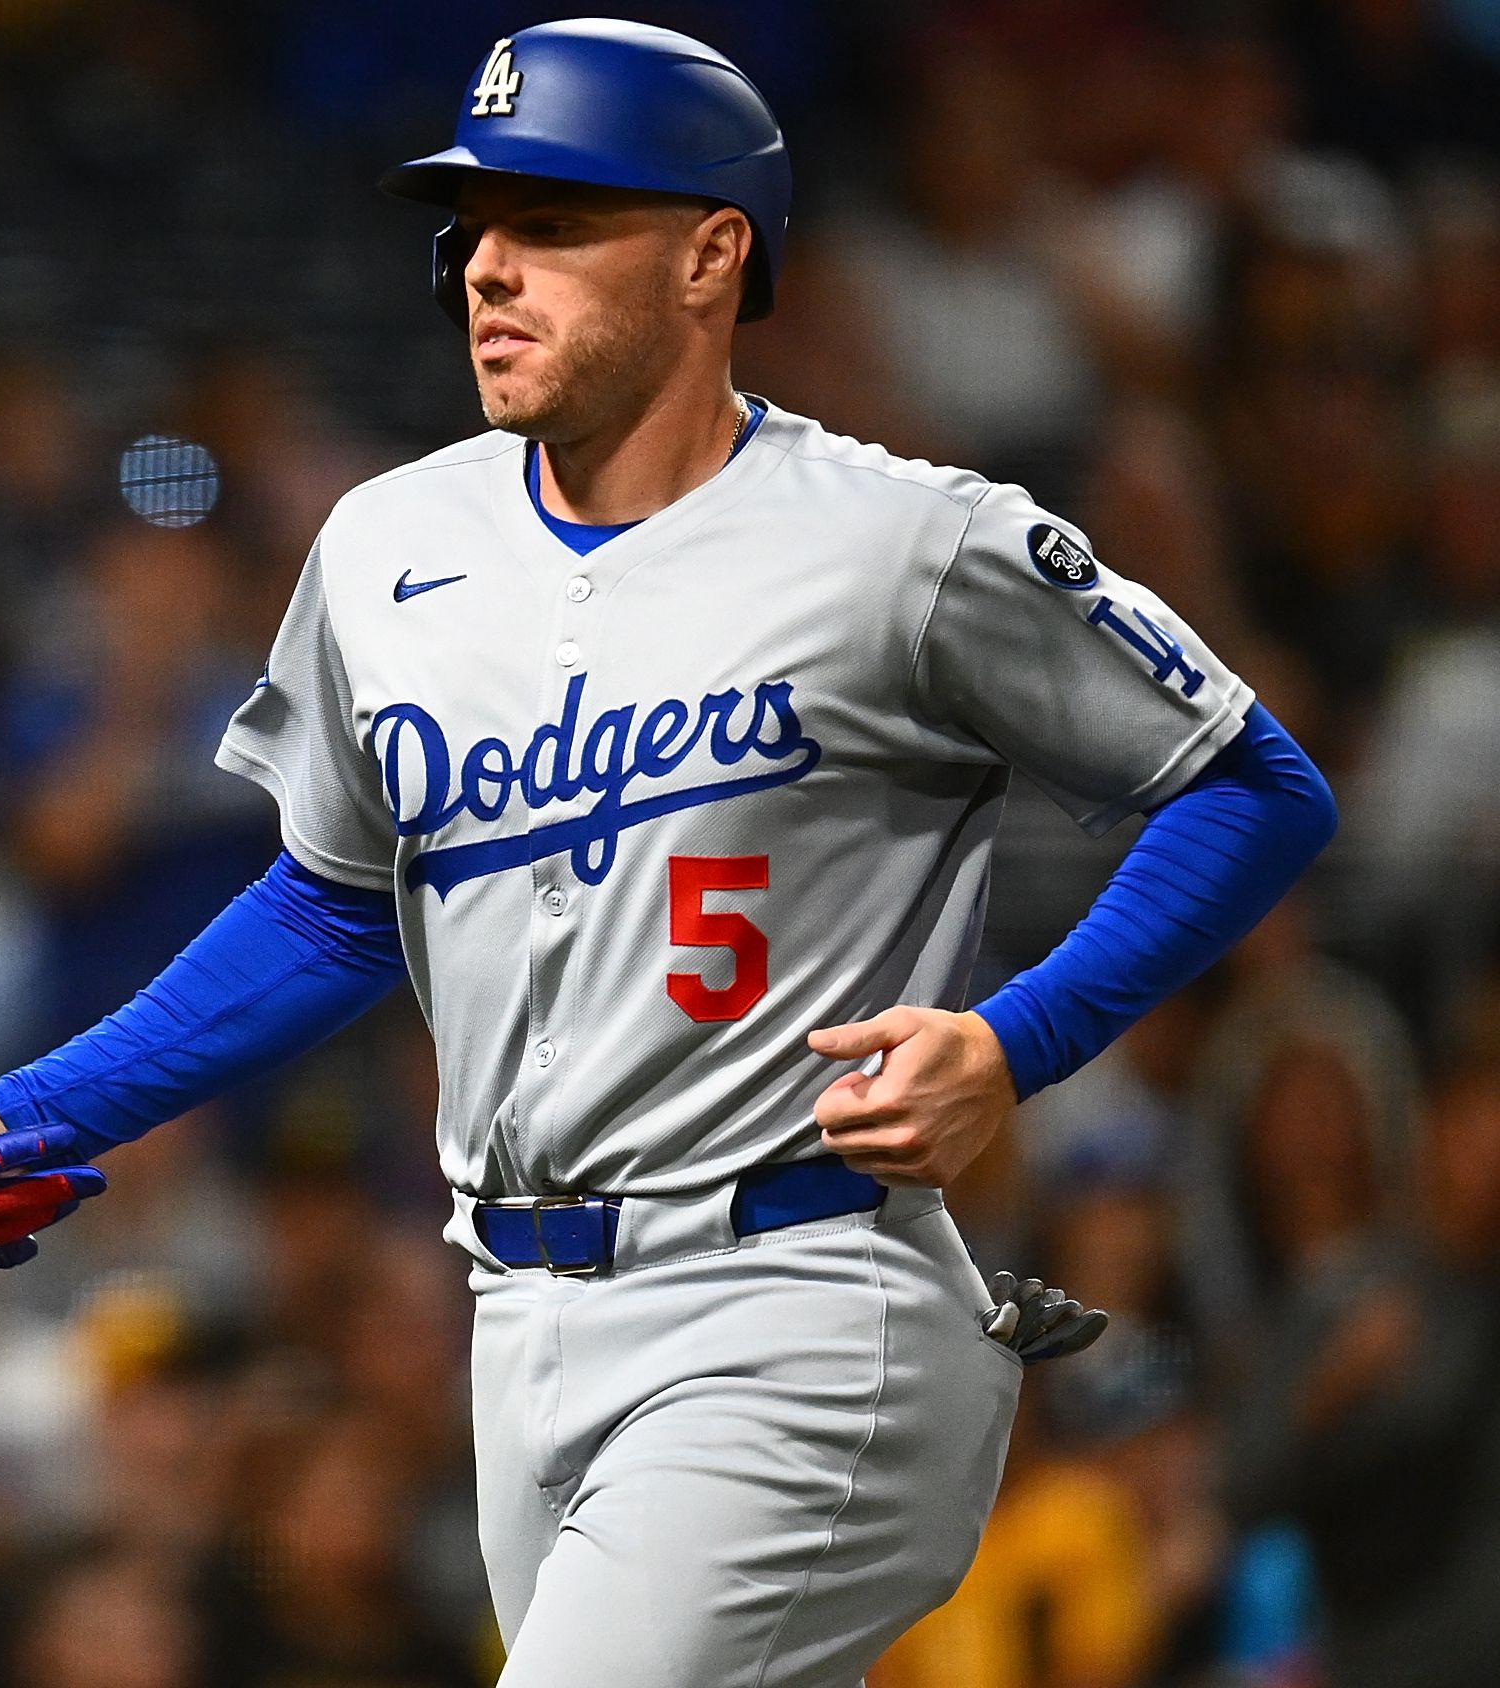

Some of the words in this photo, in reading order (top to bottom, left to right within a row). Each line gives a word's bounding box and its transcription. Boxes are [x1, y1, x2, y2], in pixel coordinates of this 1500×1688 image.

[471, 38, 520, 116] LA
[1051, 538, 1090, 580] 34
[372, 671, 822, 906] Dodgers
[667, 854, 769, 1023] 5
